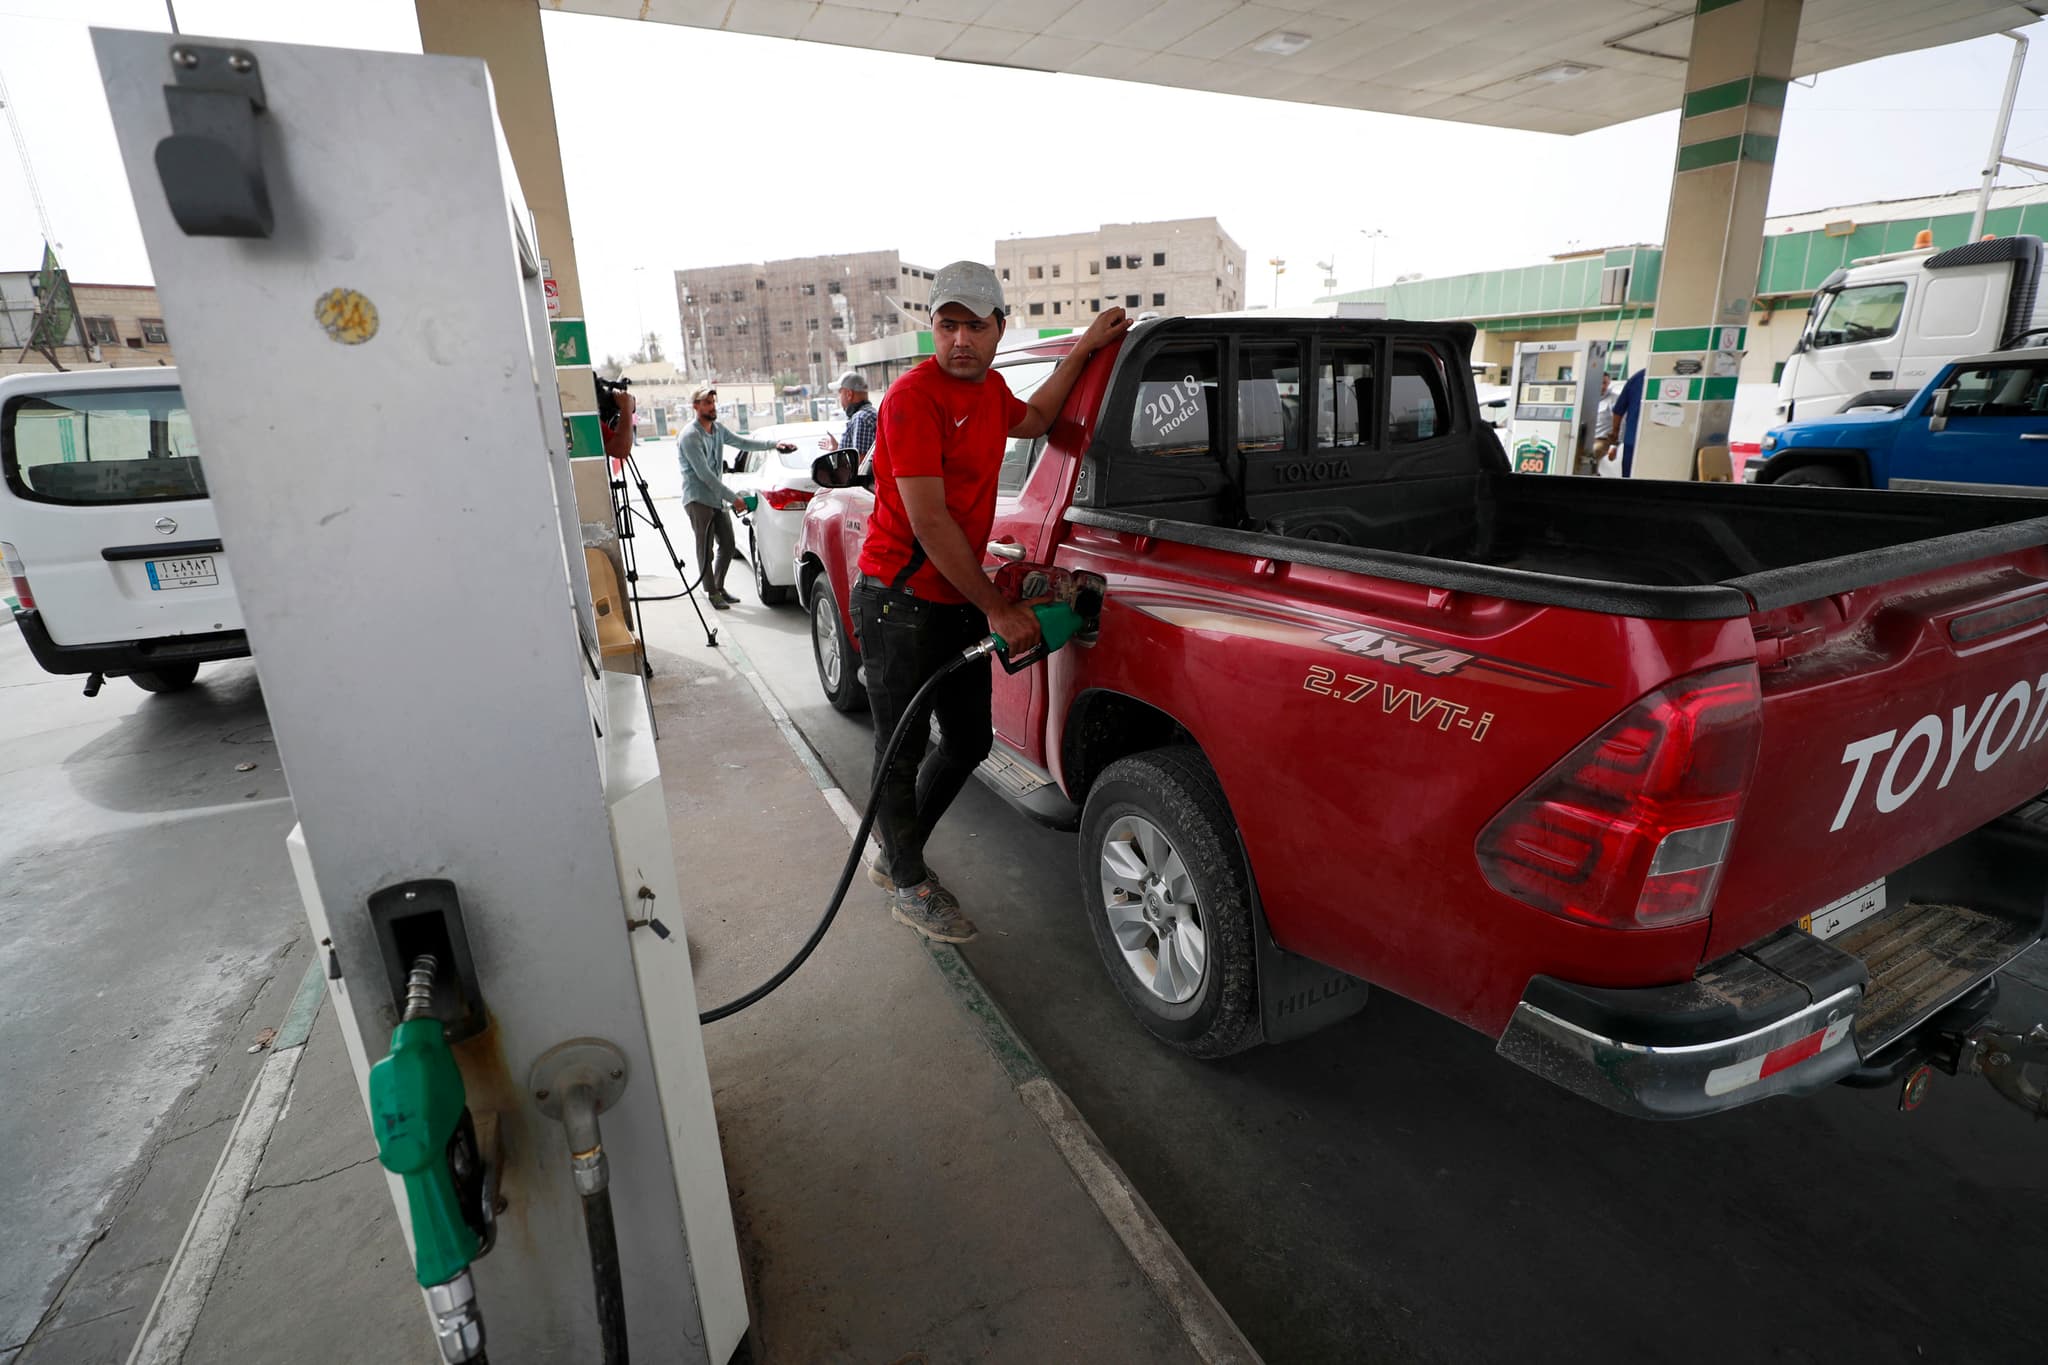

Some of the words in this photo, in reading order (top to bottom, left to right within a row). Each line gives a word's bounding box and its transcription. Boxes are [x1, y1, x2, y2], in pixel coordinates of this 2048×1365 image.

[1144, 375, 1200, 426] 2018
[1159, 400, 1200, 436] model
[1273, 459, 1352, 482] TOYOTA
[1520, 458, 1544, 472] 650
[1829, 672, 2048, 833] TOYOT
[1860, 895, 1876, 913] بغداد
